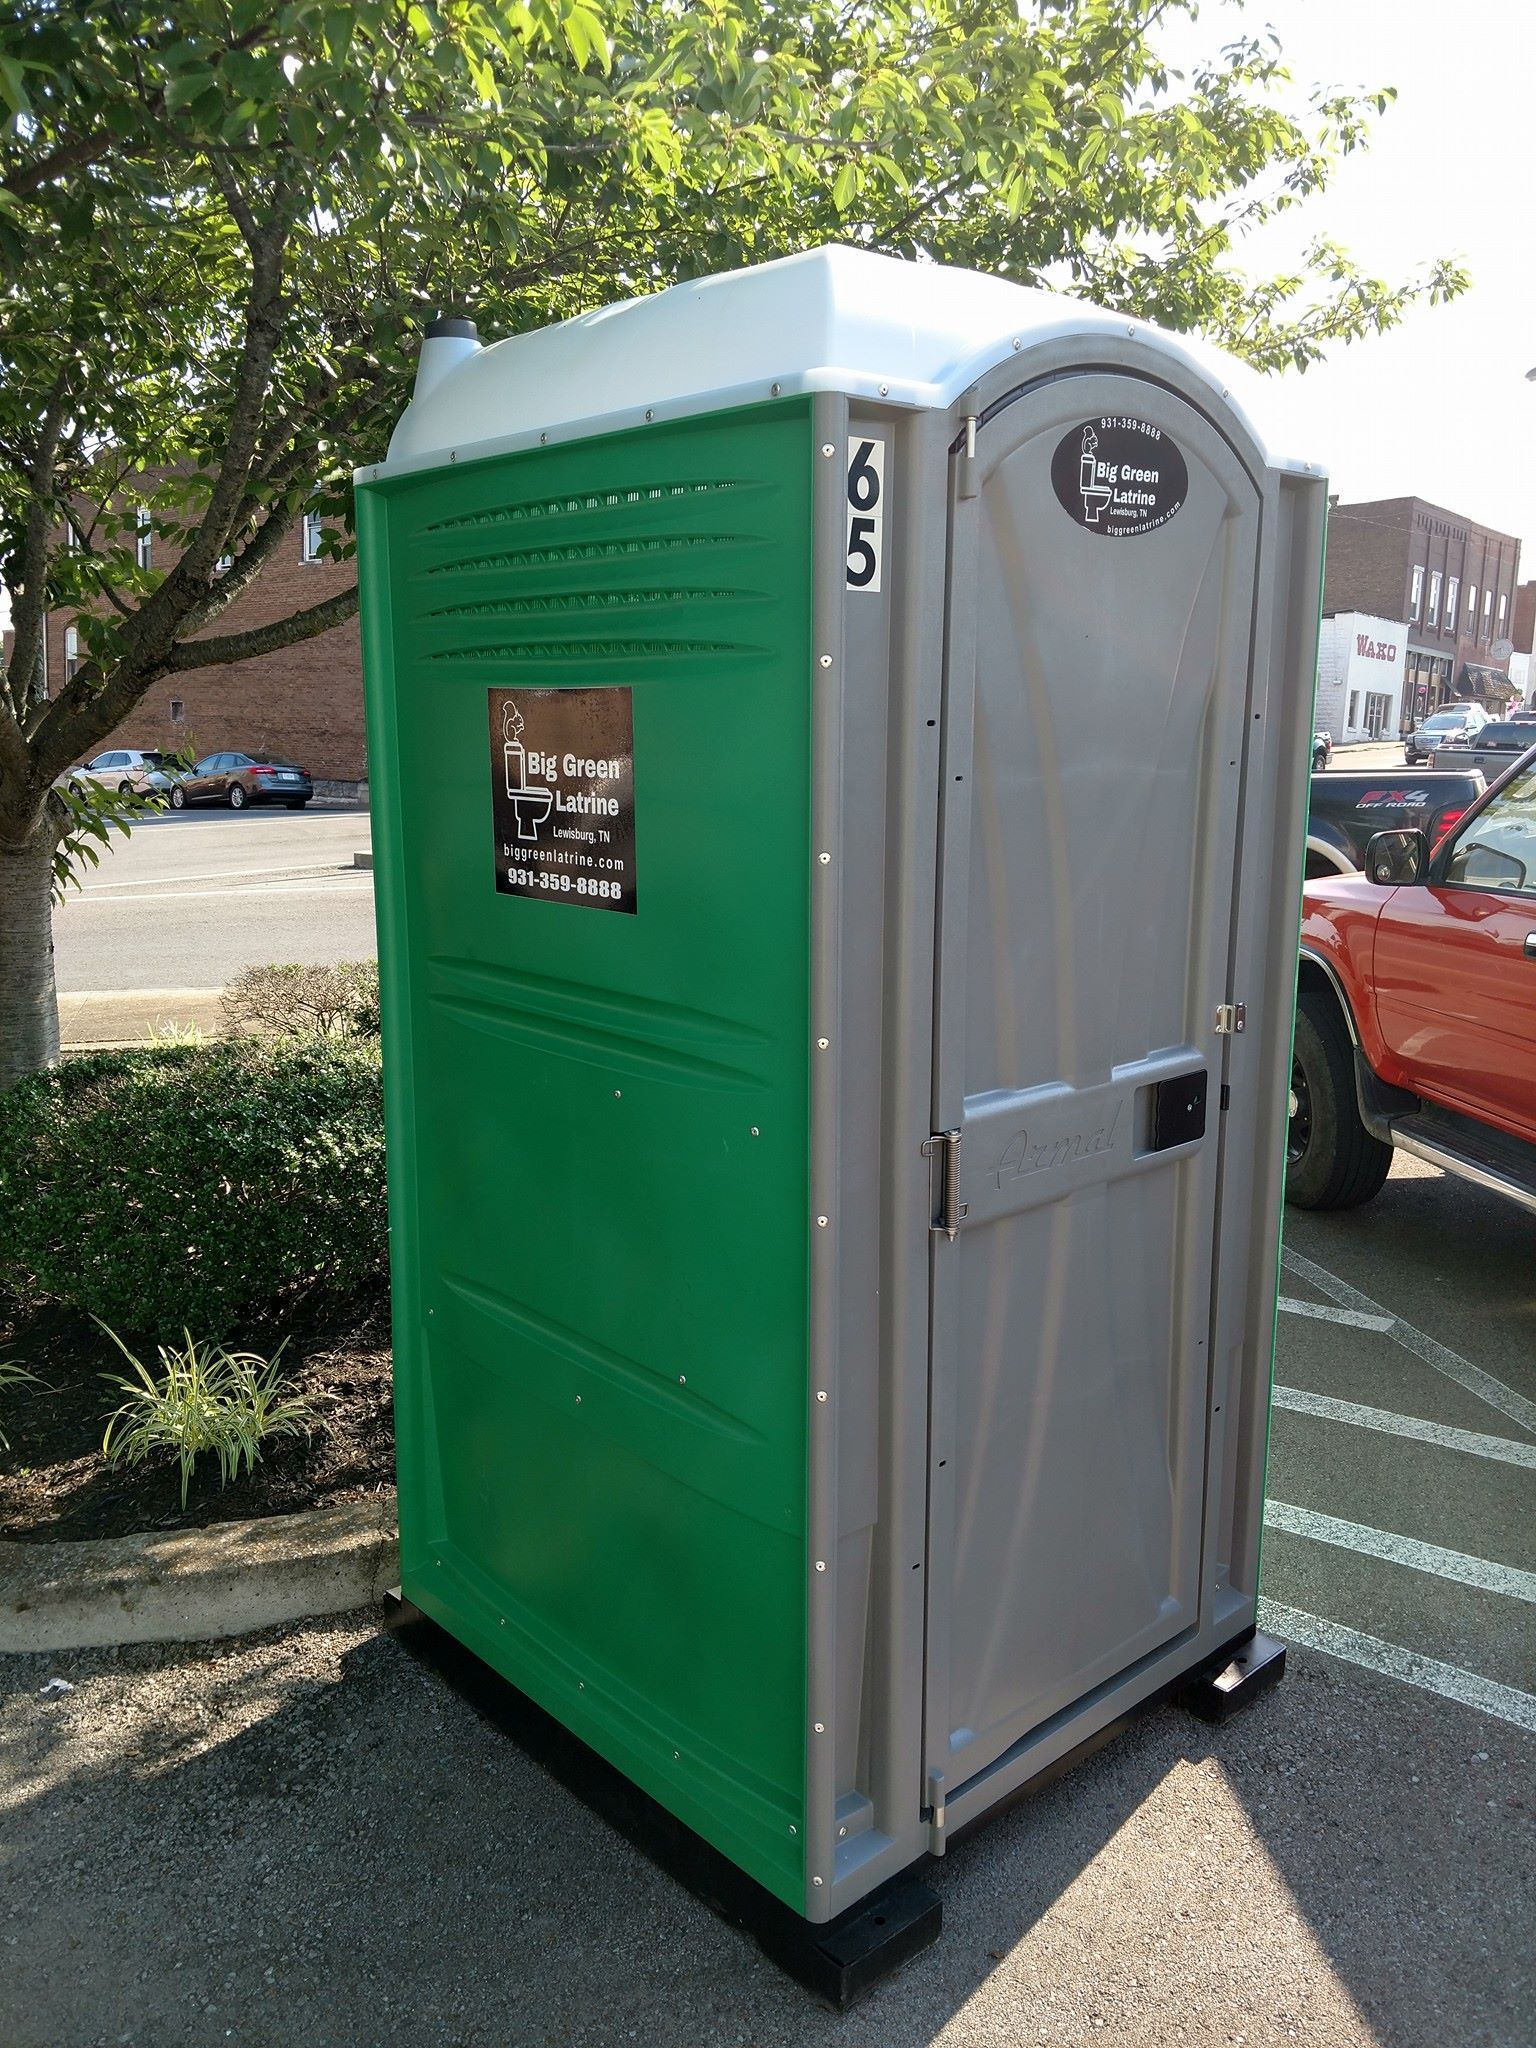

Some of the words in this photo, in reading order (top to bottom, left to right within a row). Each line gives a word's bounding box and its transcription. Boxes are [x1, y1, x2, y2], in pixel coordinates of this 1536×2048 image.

[1101, 417, 1161, 441] 931-359-8888
[1096, 462, 1118, 483] Big
[1121, 464, 1159, 483] Green
[1113, 488, 1156, 506] Latrine
[846, 441, 880, 587] 65
[1107, 501, 1181, 536] biggreenlatrine.com
[1109, 506, 1138, 519] Lewisburg,
[1140, 508, 1148, 518] TN
[1356, 634, 1397, 662] WAXO
[527, 751, 558, 782] Big
[562, 753, 620, 779] Green
[555, 790, 620, 816] Latrine
[1359, 790, 1429, 804] FX4
[553, 825, 597, 844] Lewisburg,
[598, 830, 611, 844] TN
[503, 843, 625, 871] biggreenlatrine.com
[507, 868, 622, 900] 931-359-8888
[988, 1099, 1124, 1189] Armal
